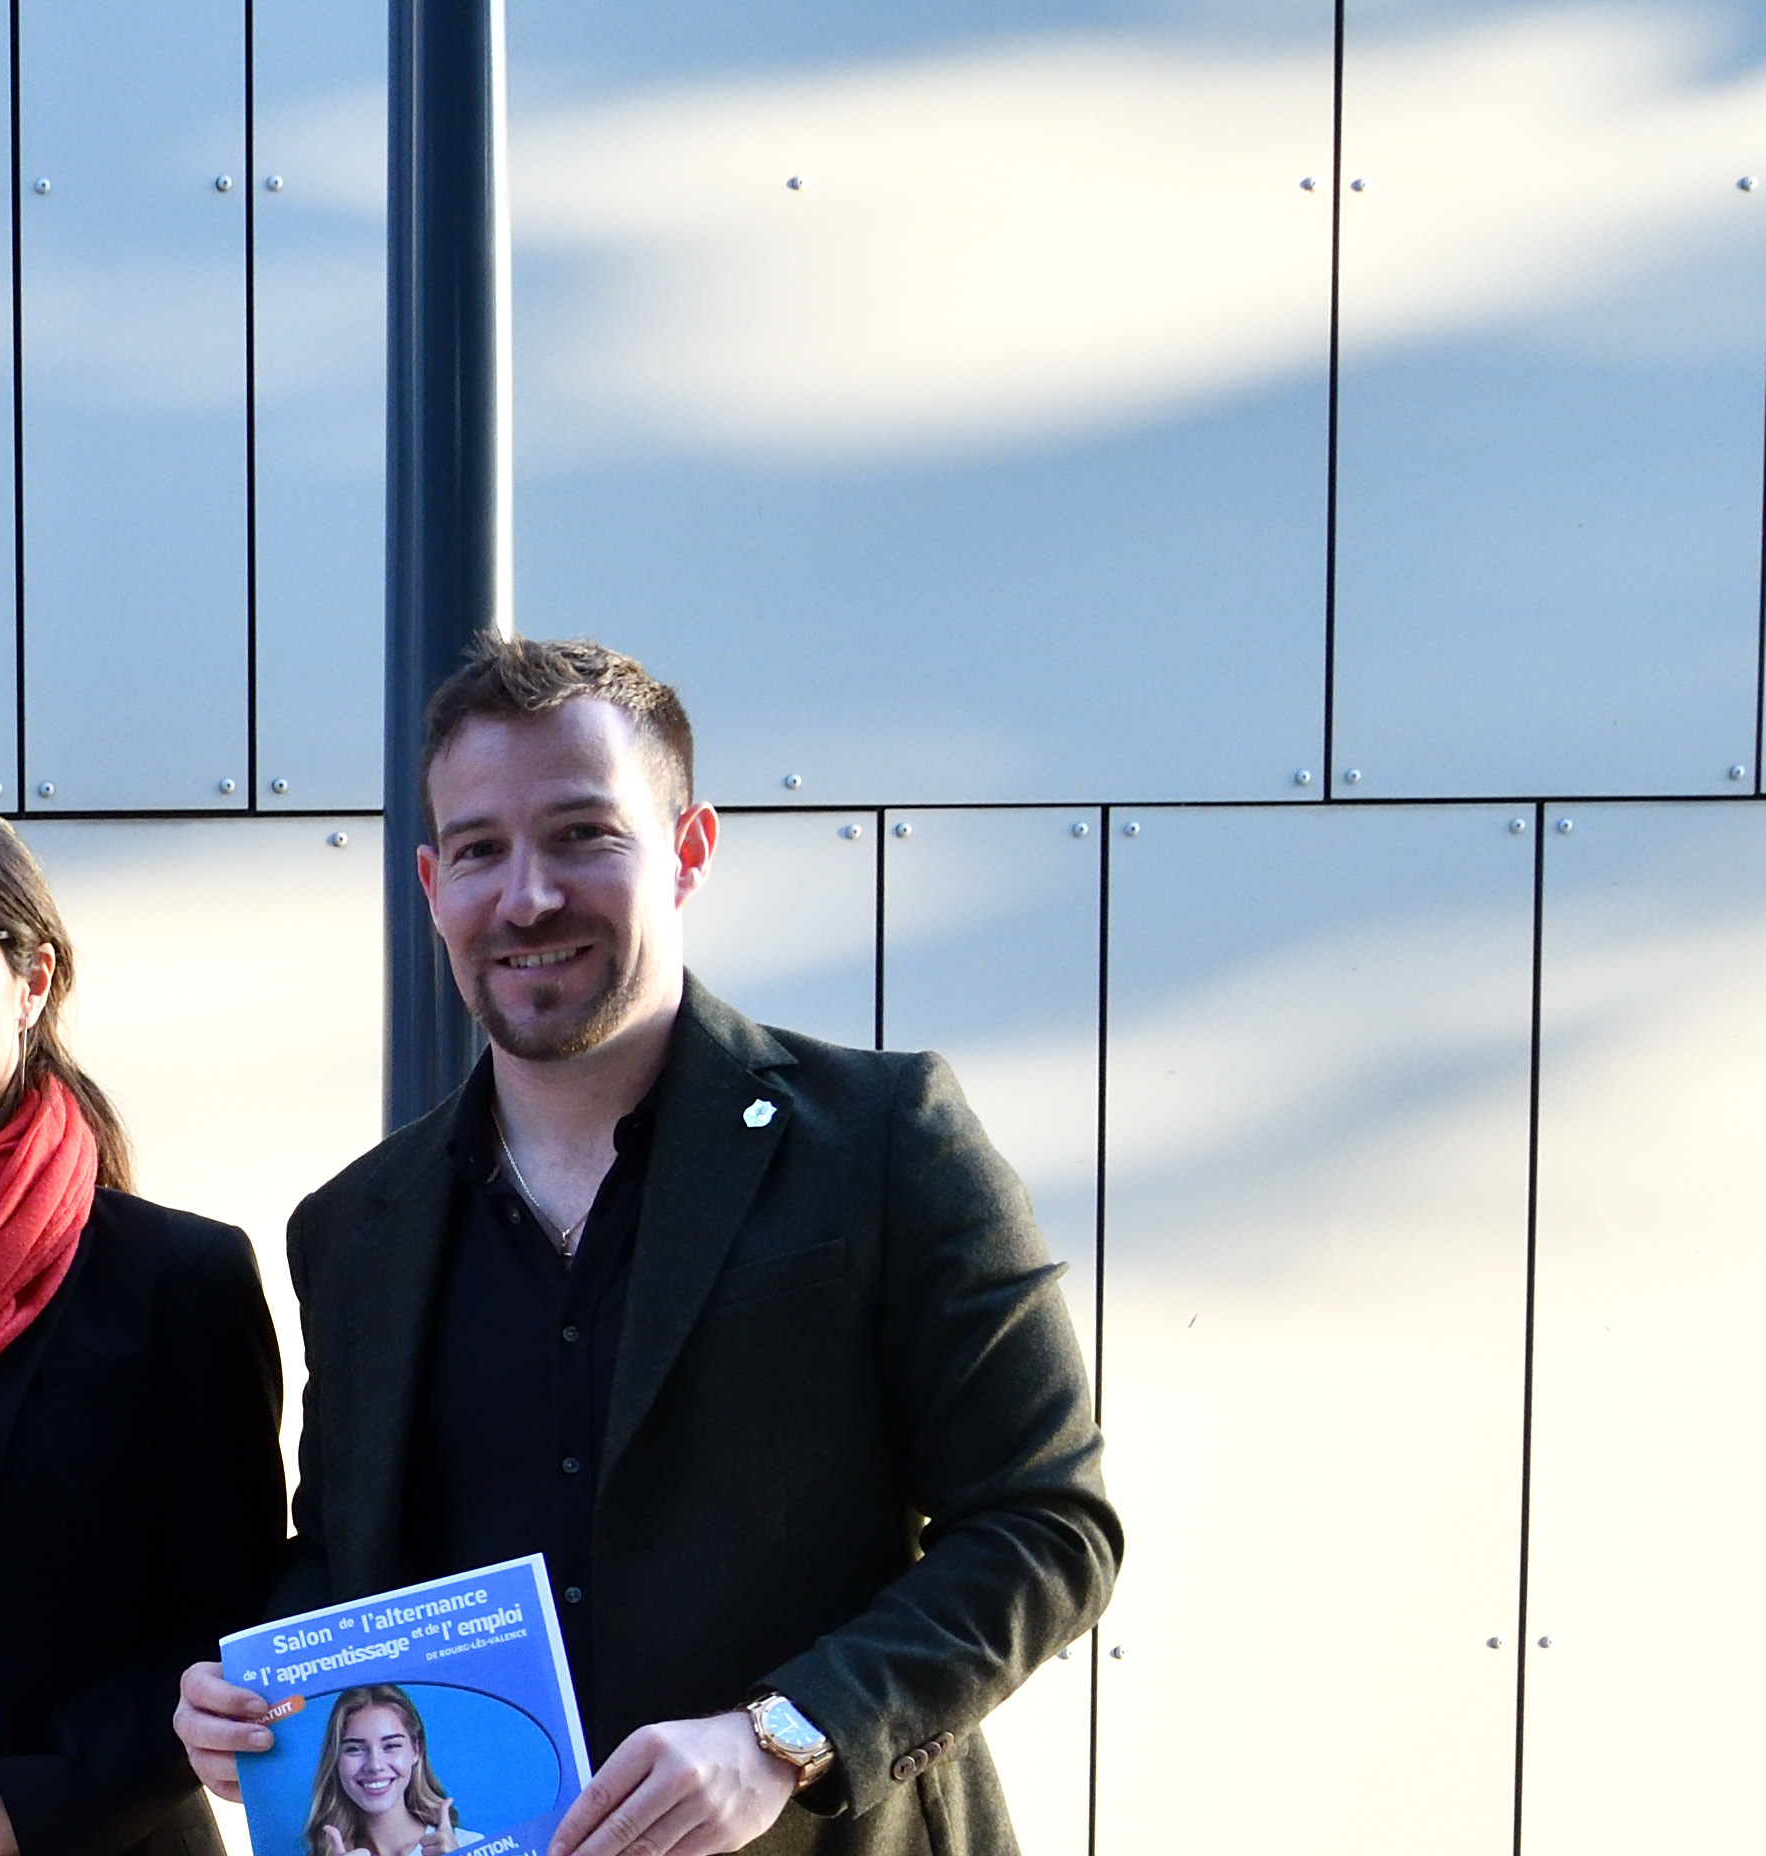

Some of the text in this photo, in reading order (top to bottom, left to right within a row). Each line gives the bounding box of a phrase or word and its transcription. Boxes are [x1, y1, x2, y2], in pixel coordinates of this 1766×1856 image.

[242, 1668, 257, 1681] de
[274, 1634, 411, 1686] apprentissage
[423, 1622, 440, 1636] de
[455, 1603, 524, 1639] emploi
[272, 1587, 489, 1655] Salon de l'alternance
